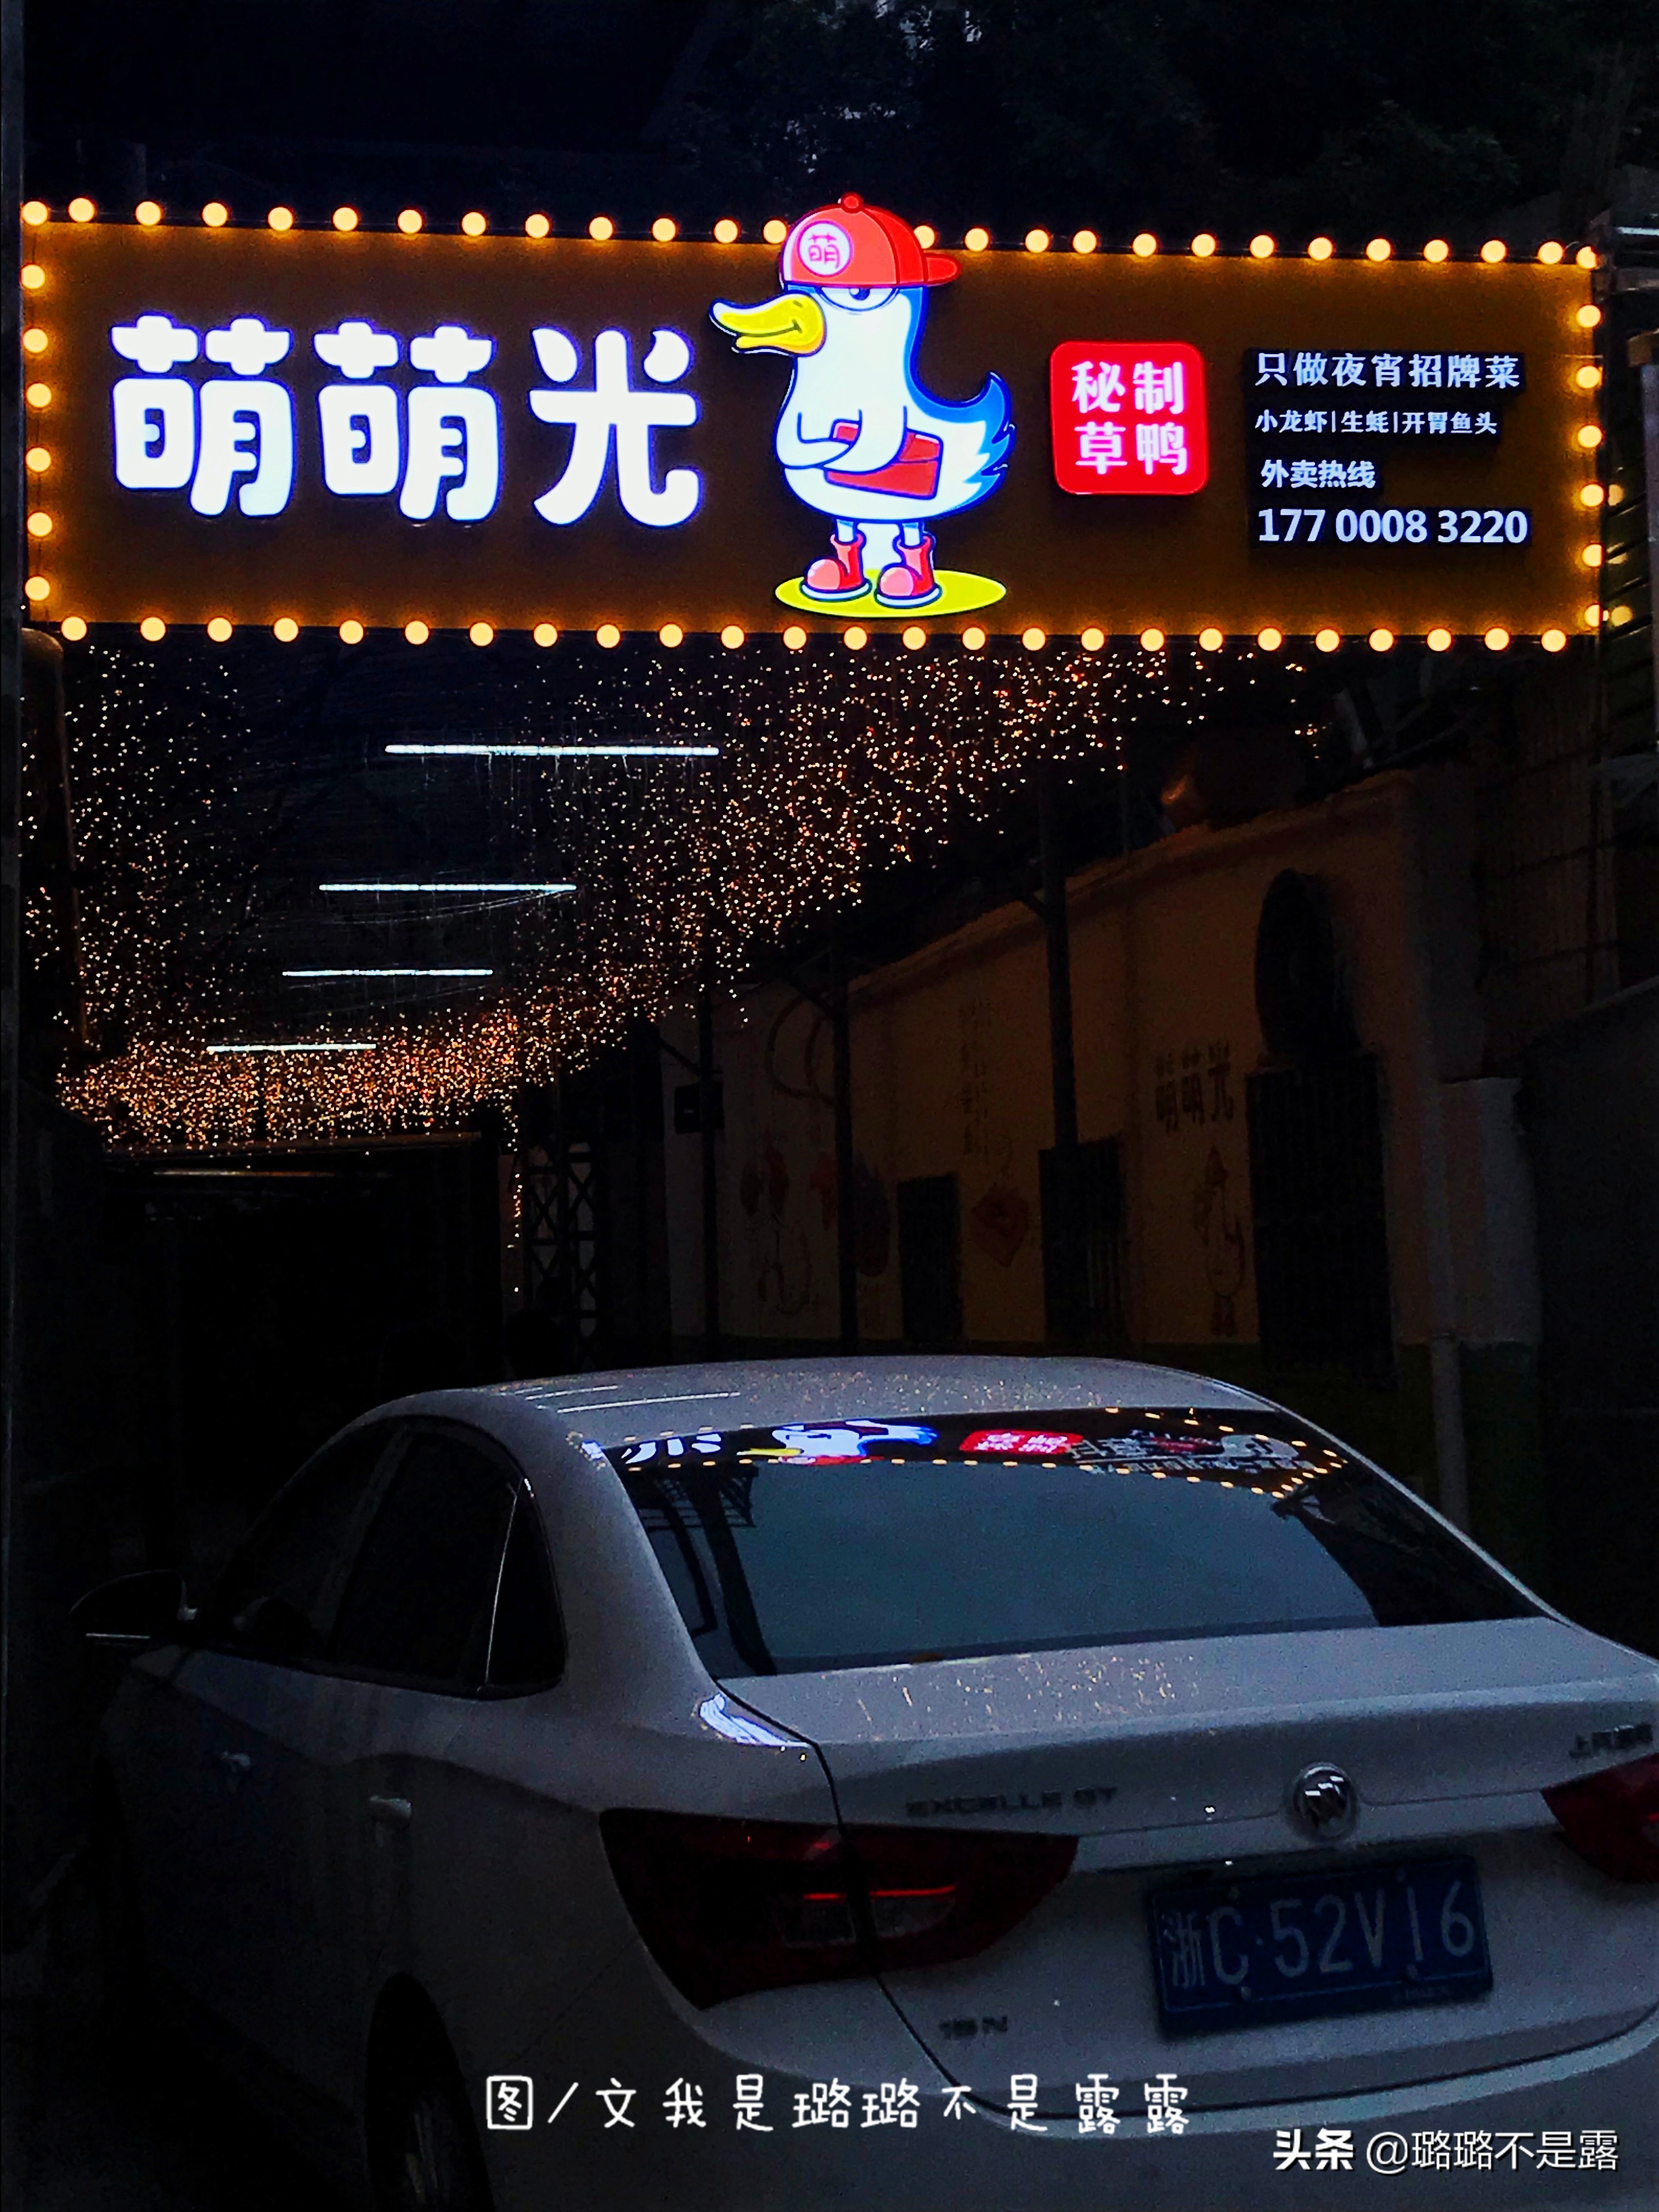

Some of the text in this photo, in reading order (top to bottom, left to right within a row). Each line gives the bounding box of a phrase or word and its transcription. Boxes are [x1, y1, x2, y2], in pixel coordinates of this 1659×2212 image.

[808, 233, 841, 269] 萌
[1071, 360, 1185, 415] 秘制
[1255, 352, 1520, 390] 只做夜宵招牌菜
[111, 314, 700, 527] 萌萌光
[1074, 422, 1188, 476] 草鸭
[1261, 459, 1376, 488] 外卖热线
[1258, 509, 1528, 544] 177 0008 3220
